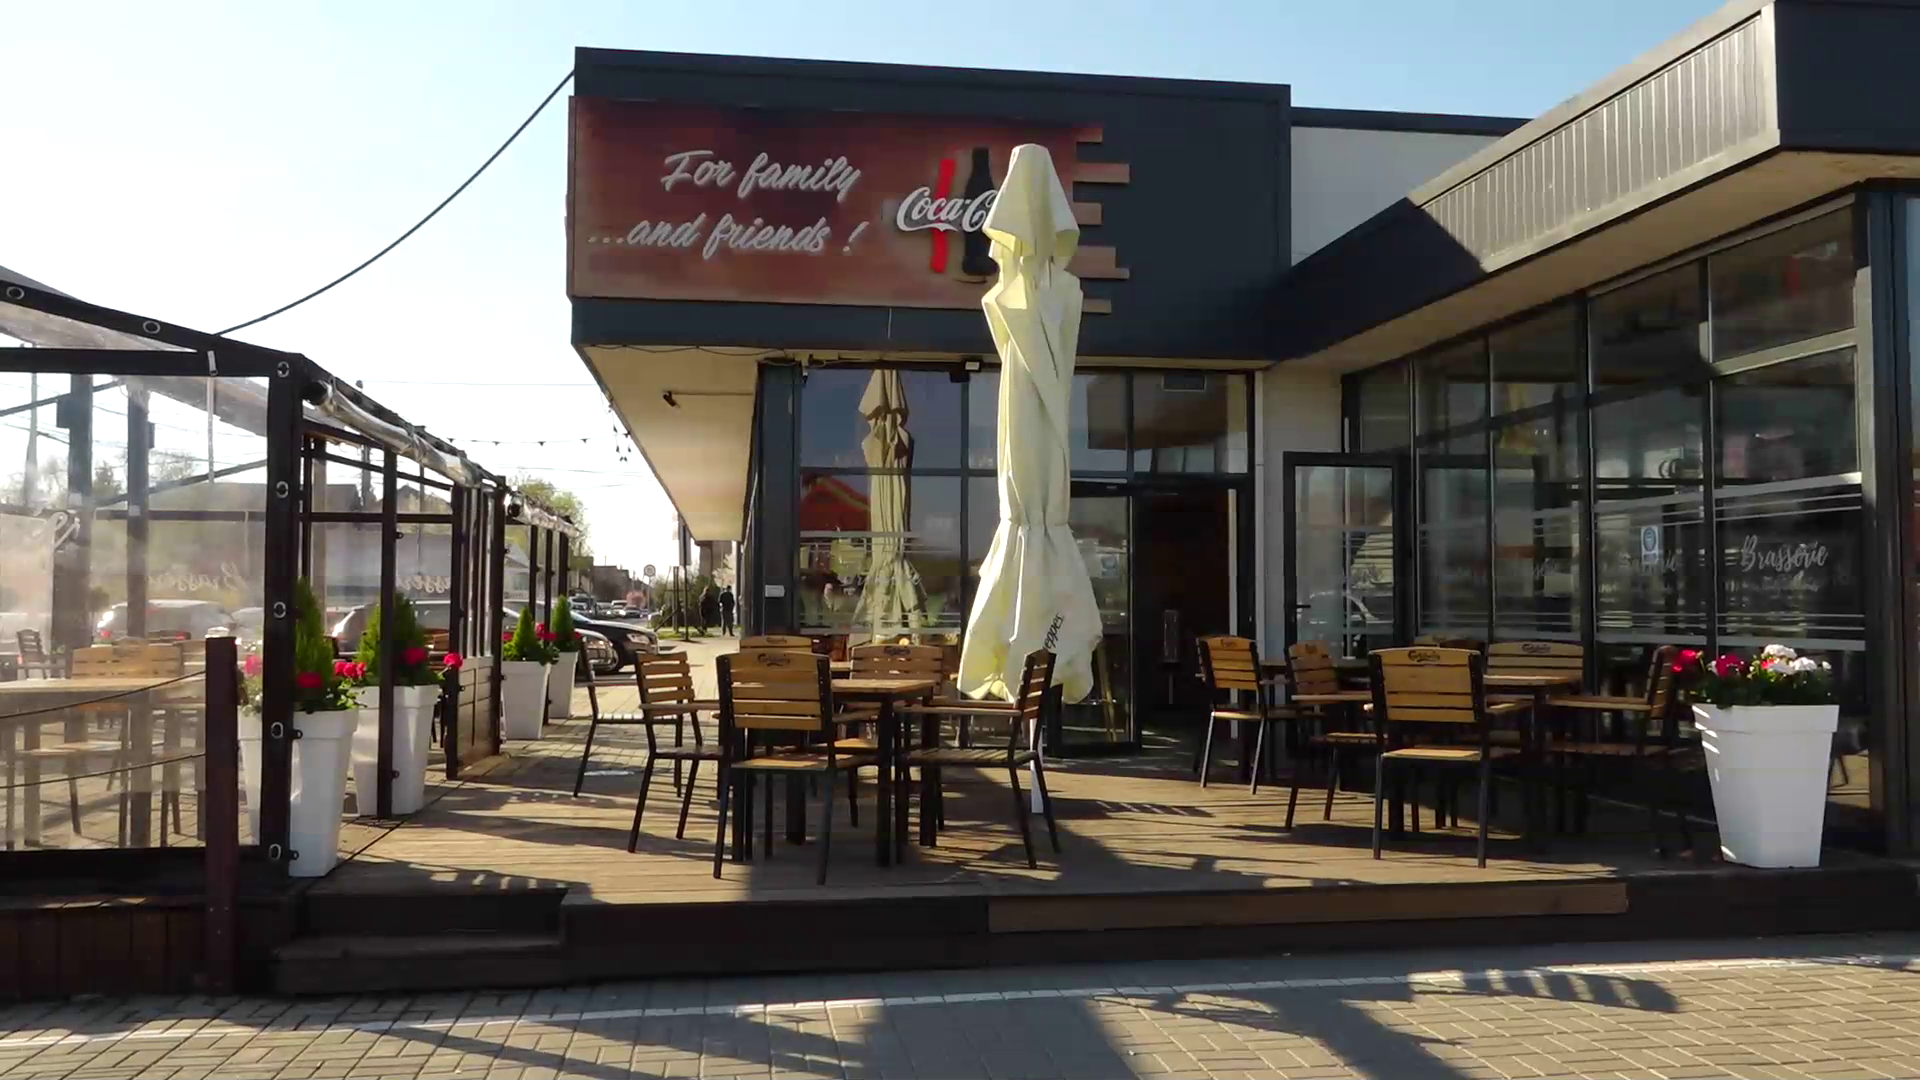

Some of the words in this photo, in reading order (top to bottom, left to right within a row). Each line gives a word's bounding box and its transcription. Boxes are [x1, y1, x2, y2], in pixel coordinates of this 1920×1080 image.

[660, 150, 736, 191] For
[737, 152, 861, 202] family
[896, 186, 998, 232] Coca-C
[702, 213, 831, 260] friends
[1740, 534, 1829, 572] Brasserie
[1043, 612, 1064, 650] eppes
